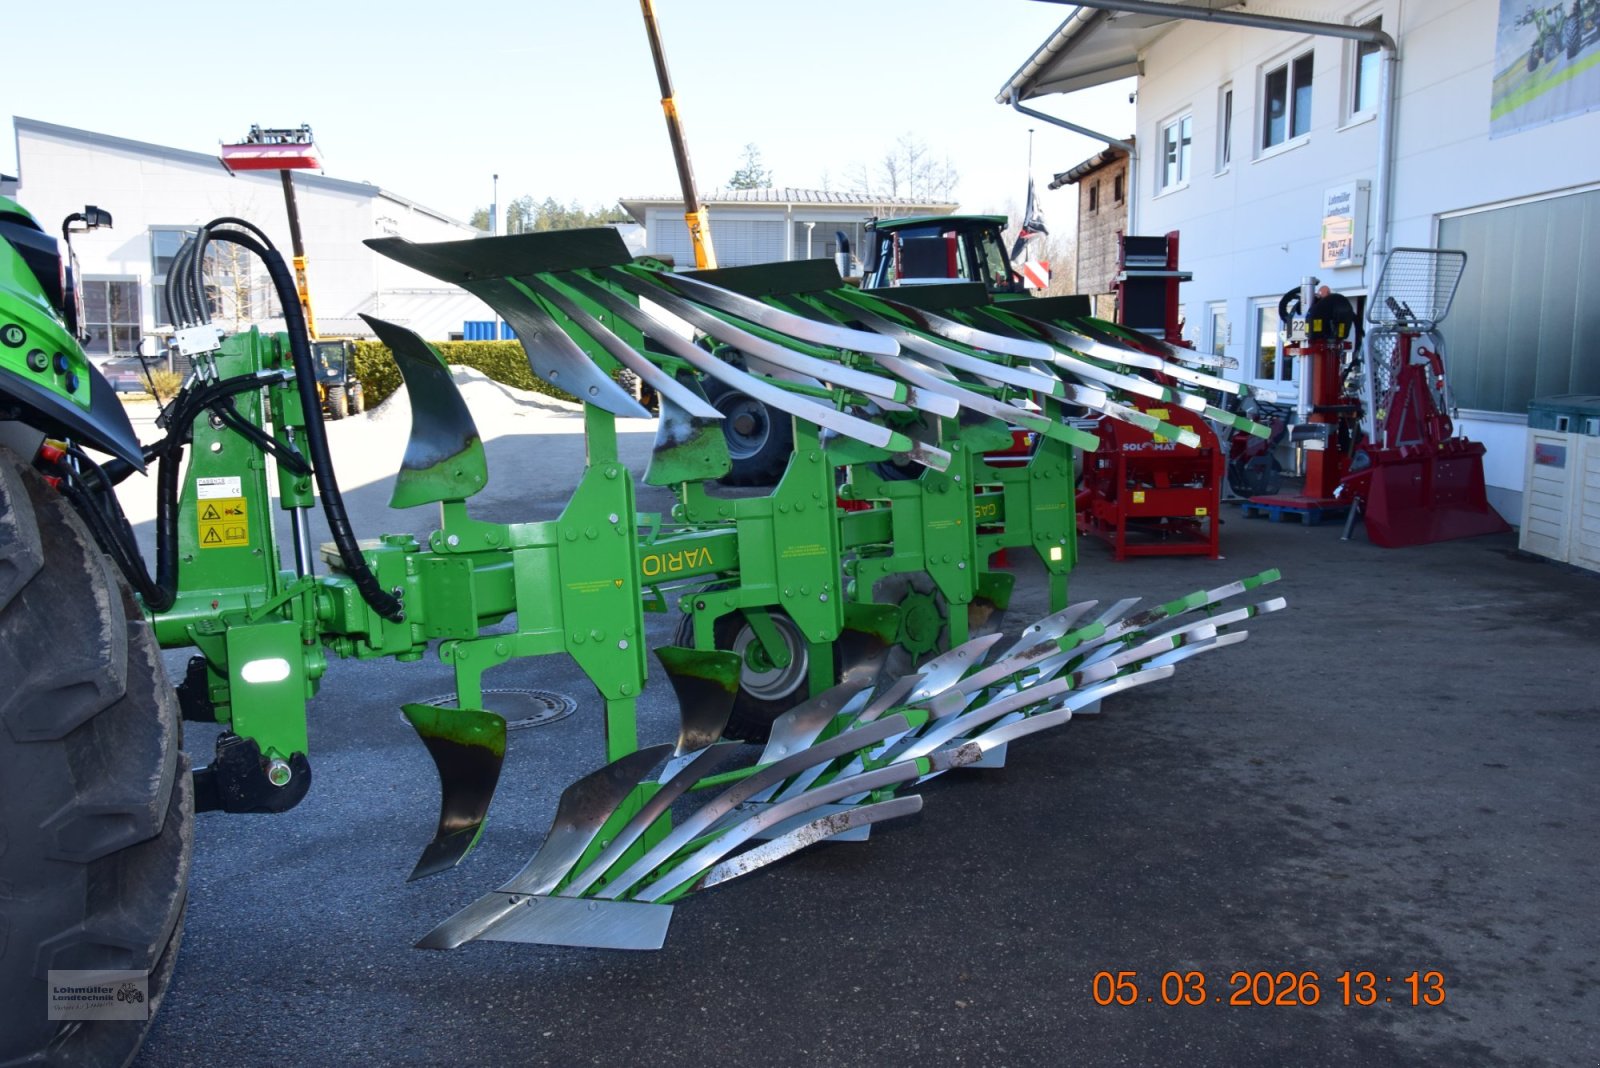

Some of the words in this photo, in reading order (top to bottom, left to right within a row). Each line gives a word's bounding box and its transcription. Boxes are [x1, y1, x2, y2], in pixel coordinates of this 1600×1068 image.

[1328, 239, 1347, 250] DEUTZ
[1328, 248, 1344, 258] FAHR
[642, 546, 713, 576] VARIO
